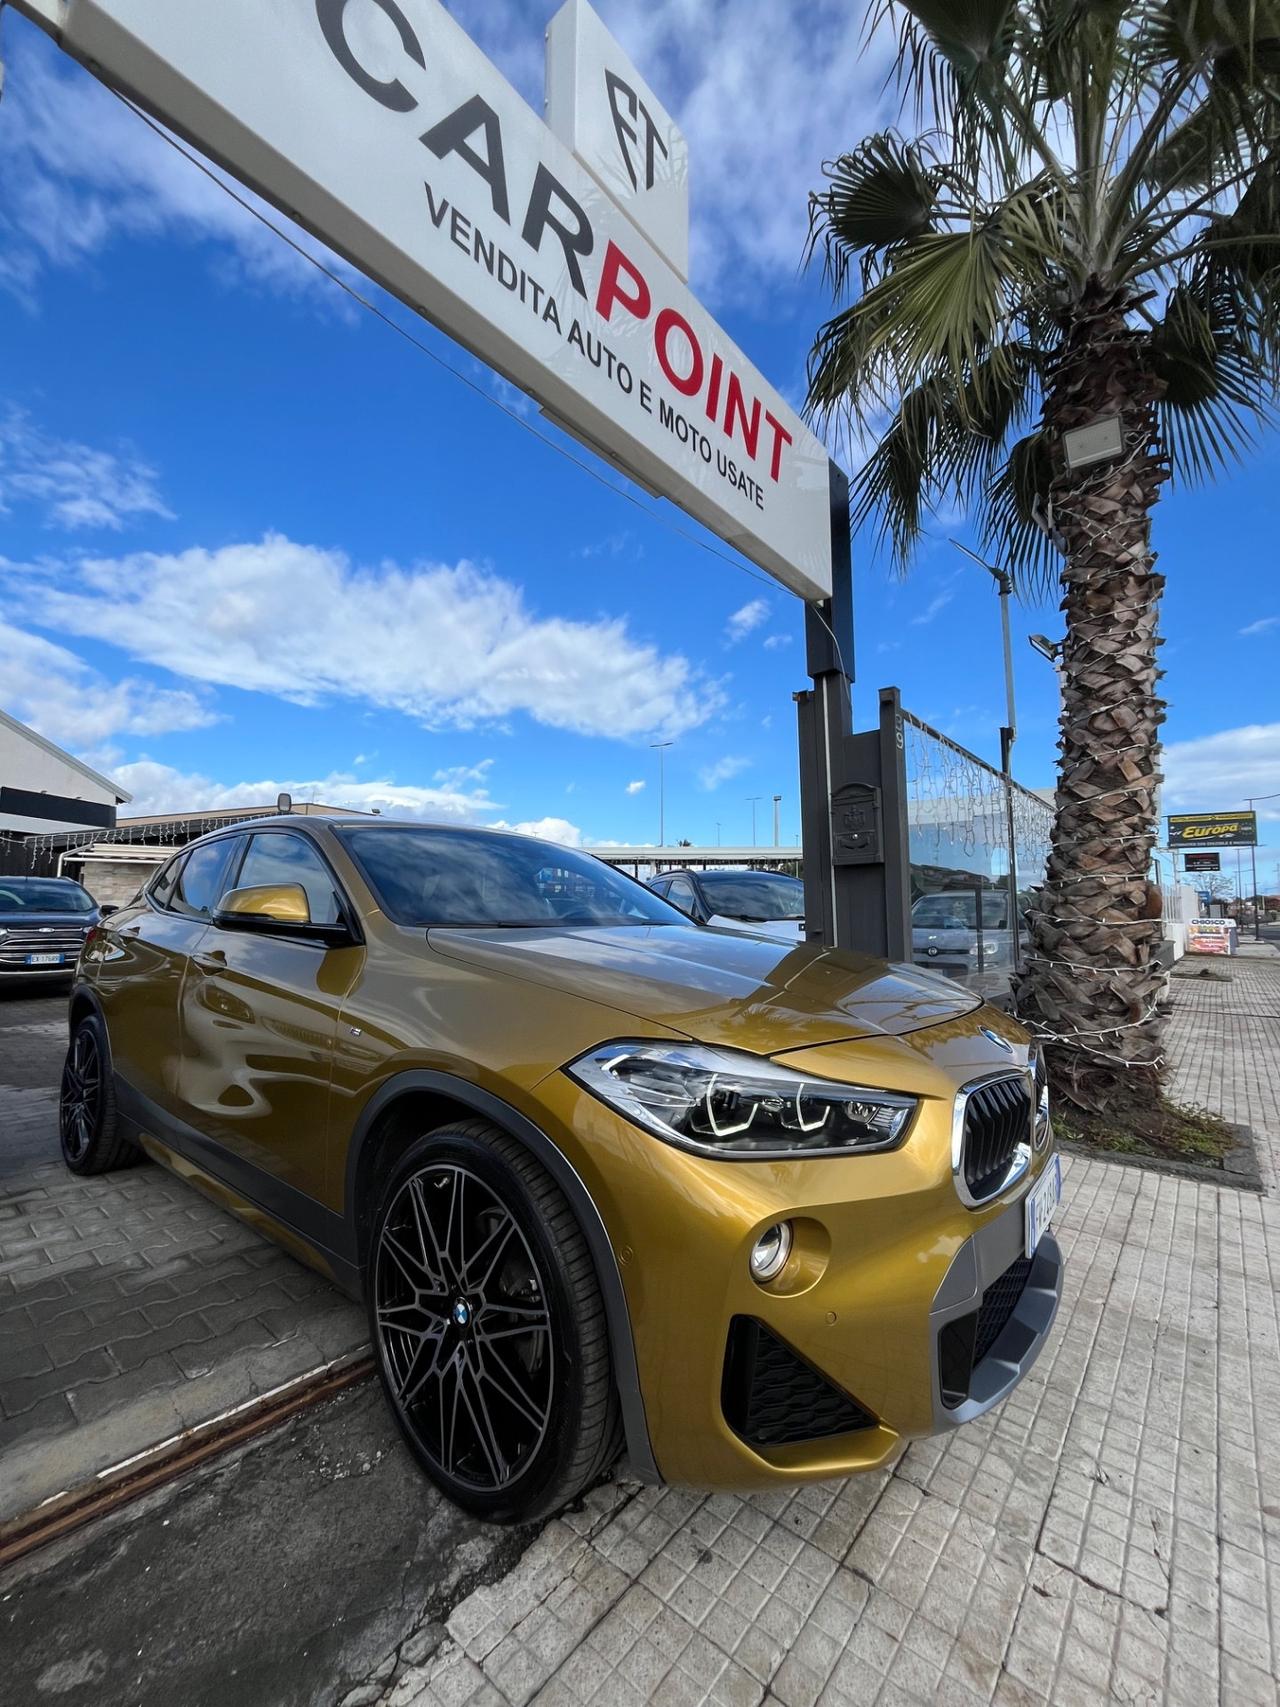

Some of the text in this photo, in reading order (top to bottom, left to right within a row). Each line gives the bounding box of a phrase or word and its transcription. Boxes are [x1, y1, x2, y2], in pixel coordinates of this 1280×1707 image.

[424, 181, 764, 511] VENDITA AUTO E MOTO USATE
[1182, 823, 1239, 839] Europa
